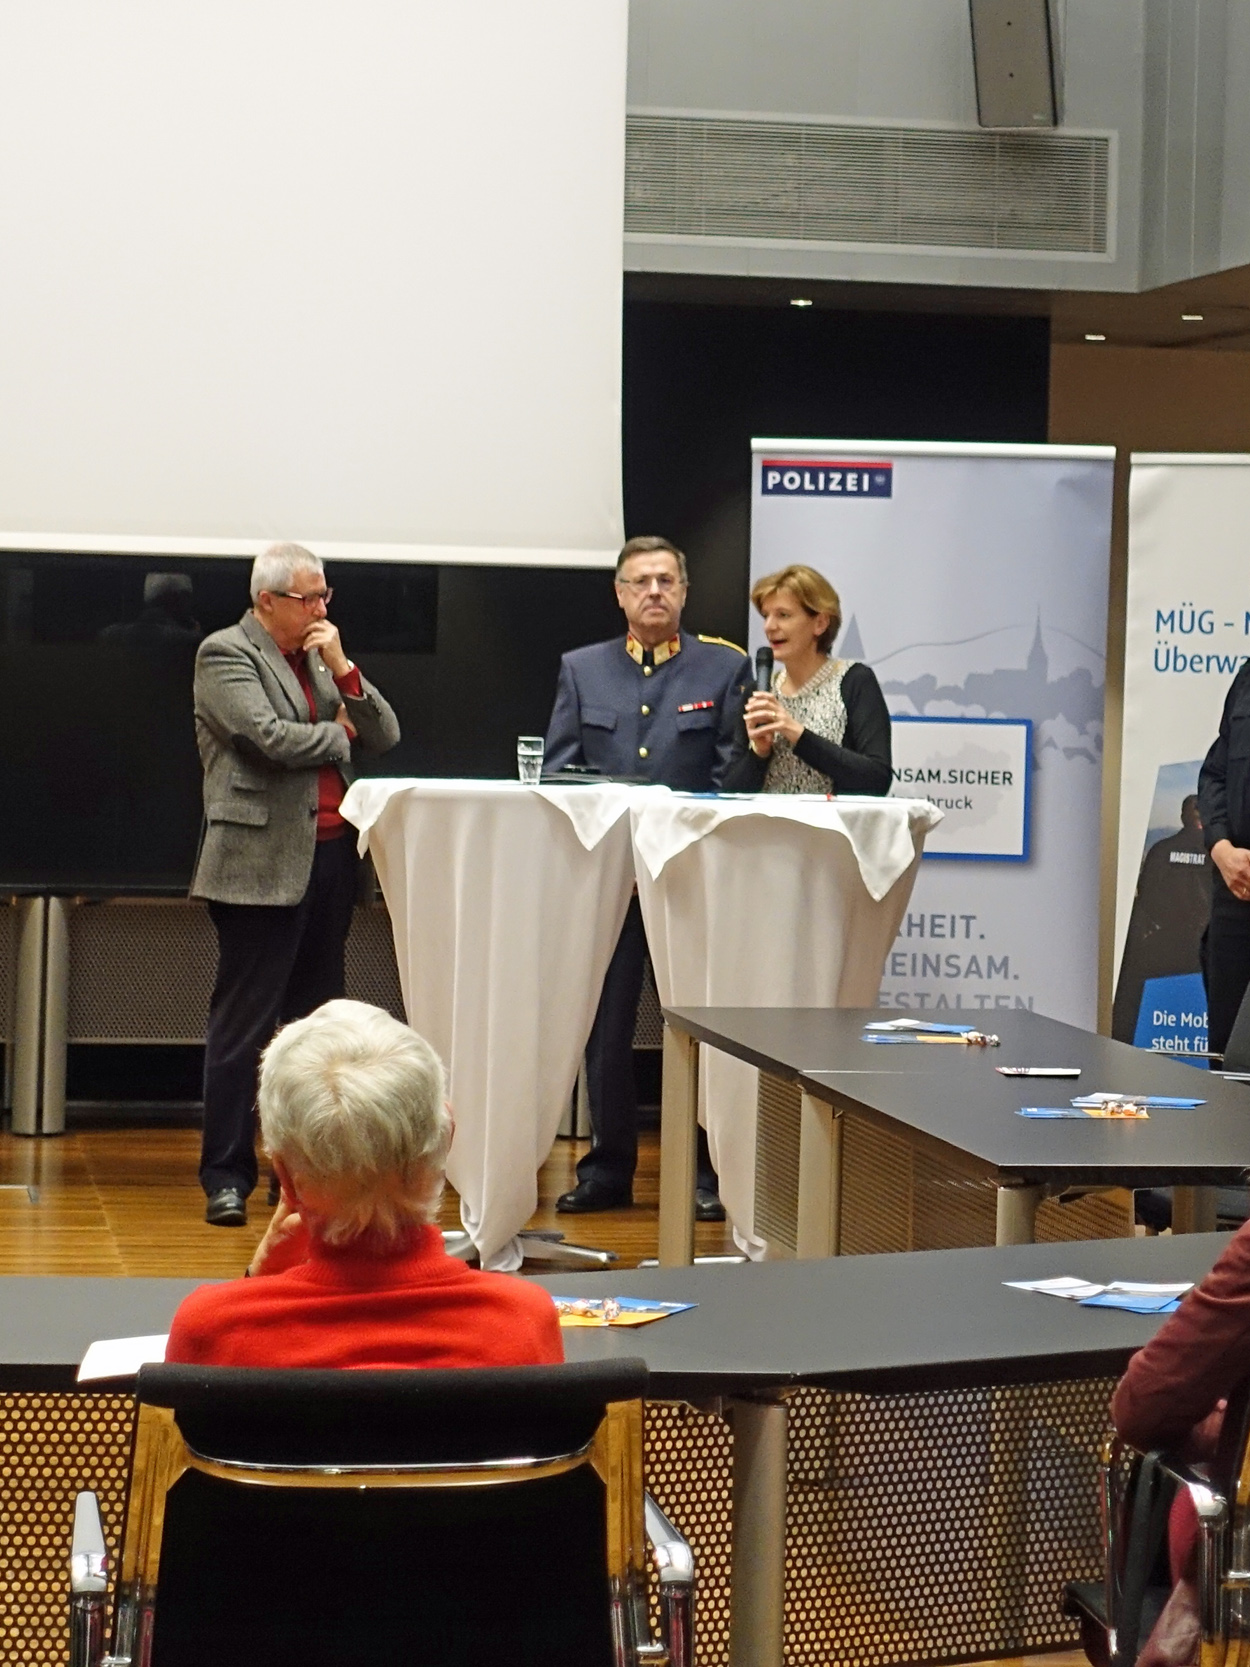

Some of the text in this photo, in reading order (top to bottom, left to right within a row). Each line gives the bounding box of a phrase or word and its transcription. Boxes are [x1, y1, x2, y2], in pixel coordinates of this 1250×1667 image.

[767, 470, 870, 491] POLIZEI
[1155, 602, 1215, 635] MÜG
[899, 913, 985, 939] HEIT.
[883, 952, 1020, 980] EINSAM.
[1153, 1010, 1177, 1026] Die
[1151, 1035, 1190, 1051] steht
